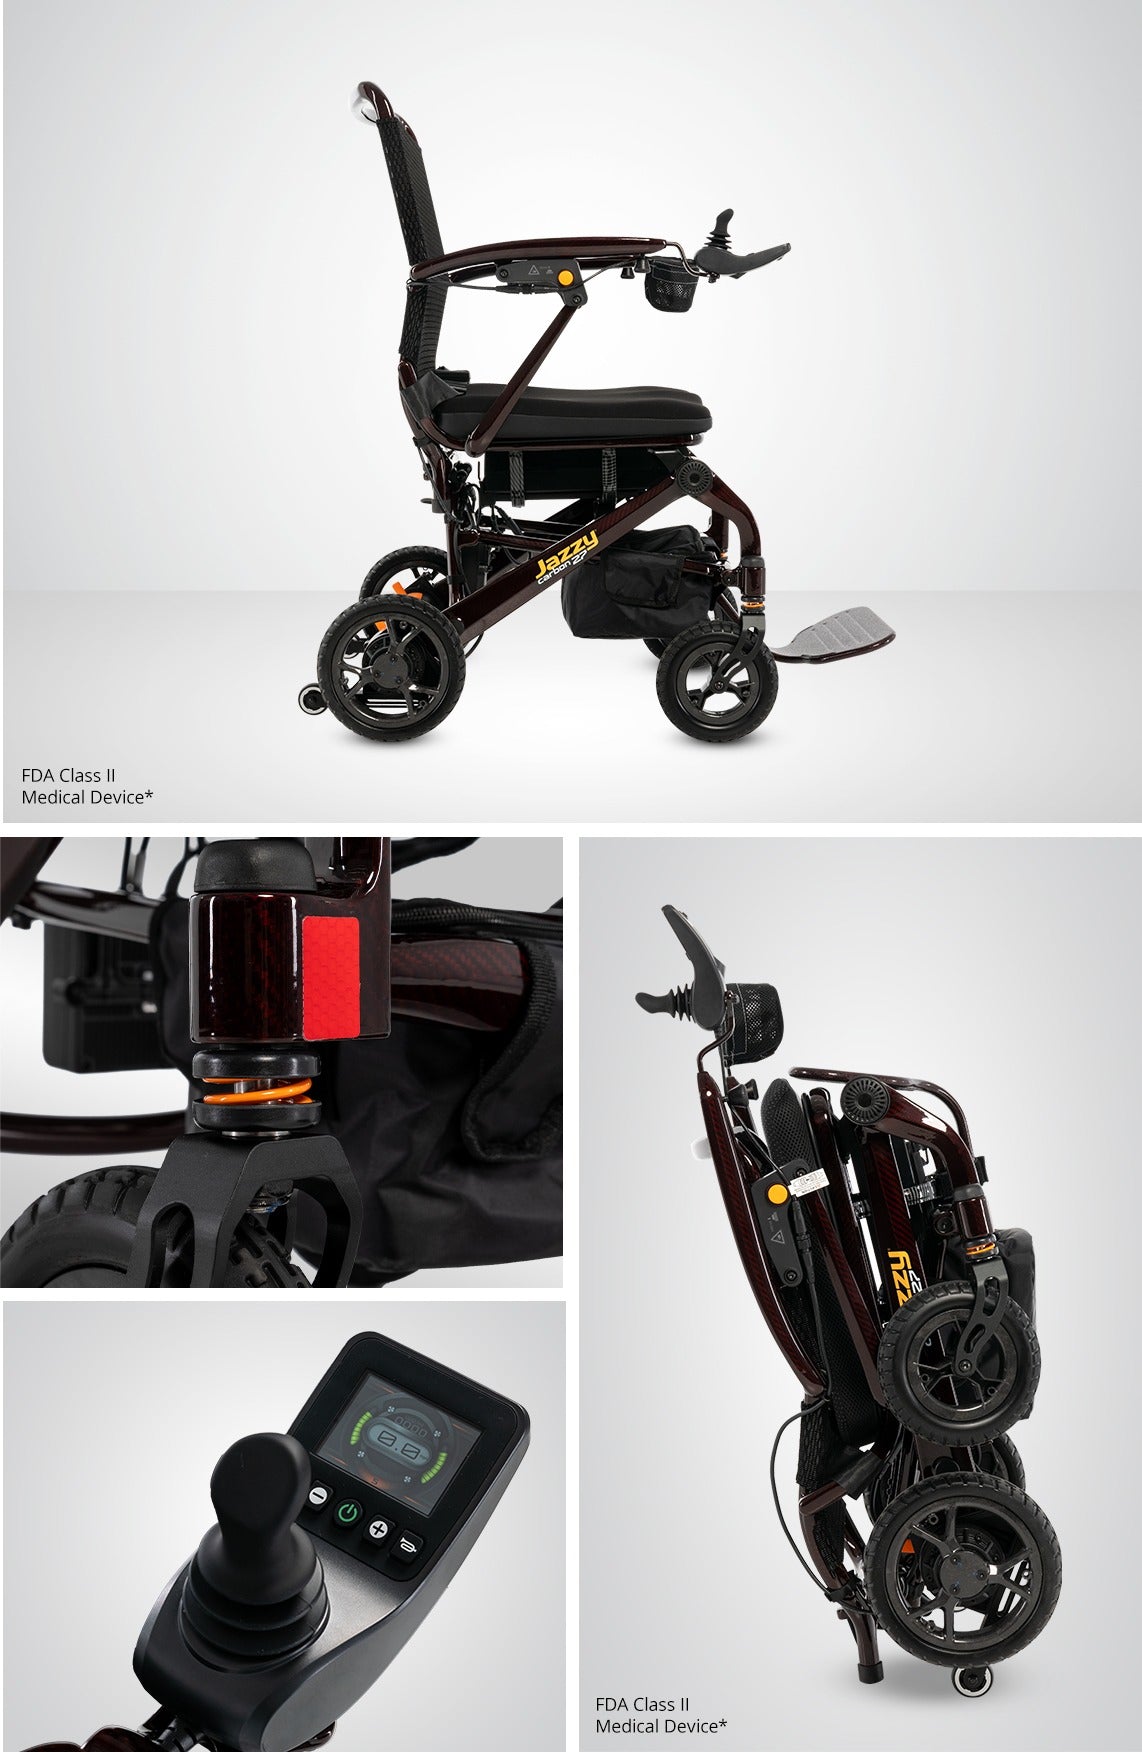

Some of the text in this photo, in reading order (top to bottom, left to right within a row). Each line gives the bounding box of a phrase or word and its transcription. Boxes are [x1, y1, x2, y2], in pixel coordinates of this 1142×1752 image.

[535, 530, 599, 579] Jazzy
[537, 549, 588, 585] carbon 27
